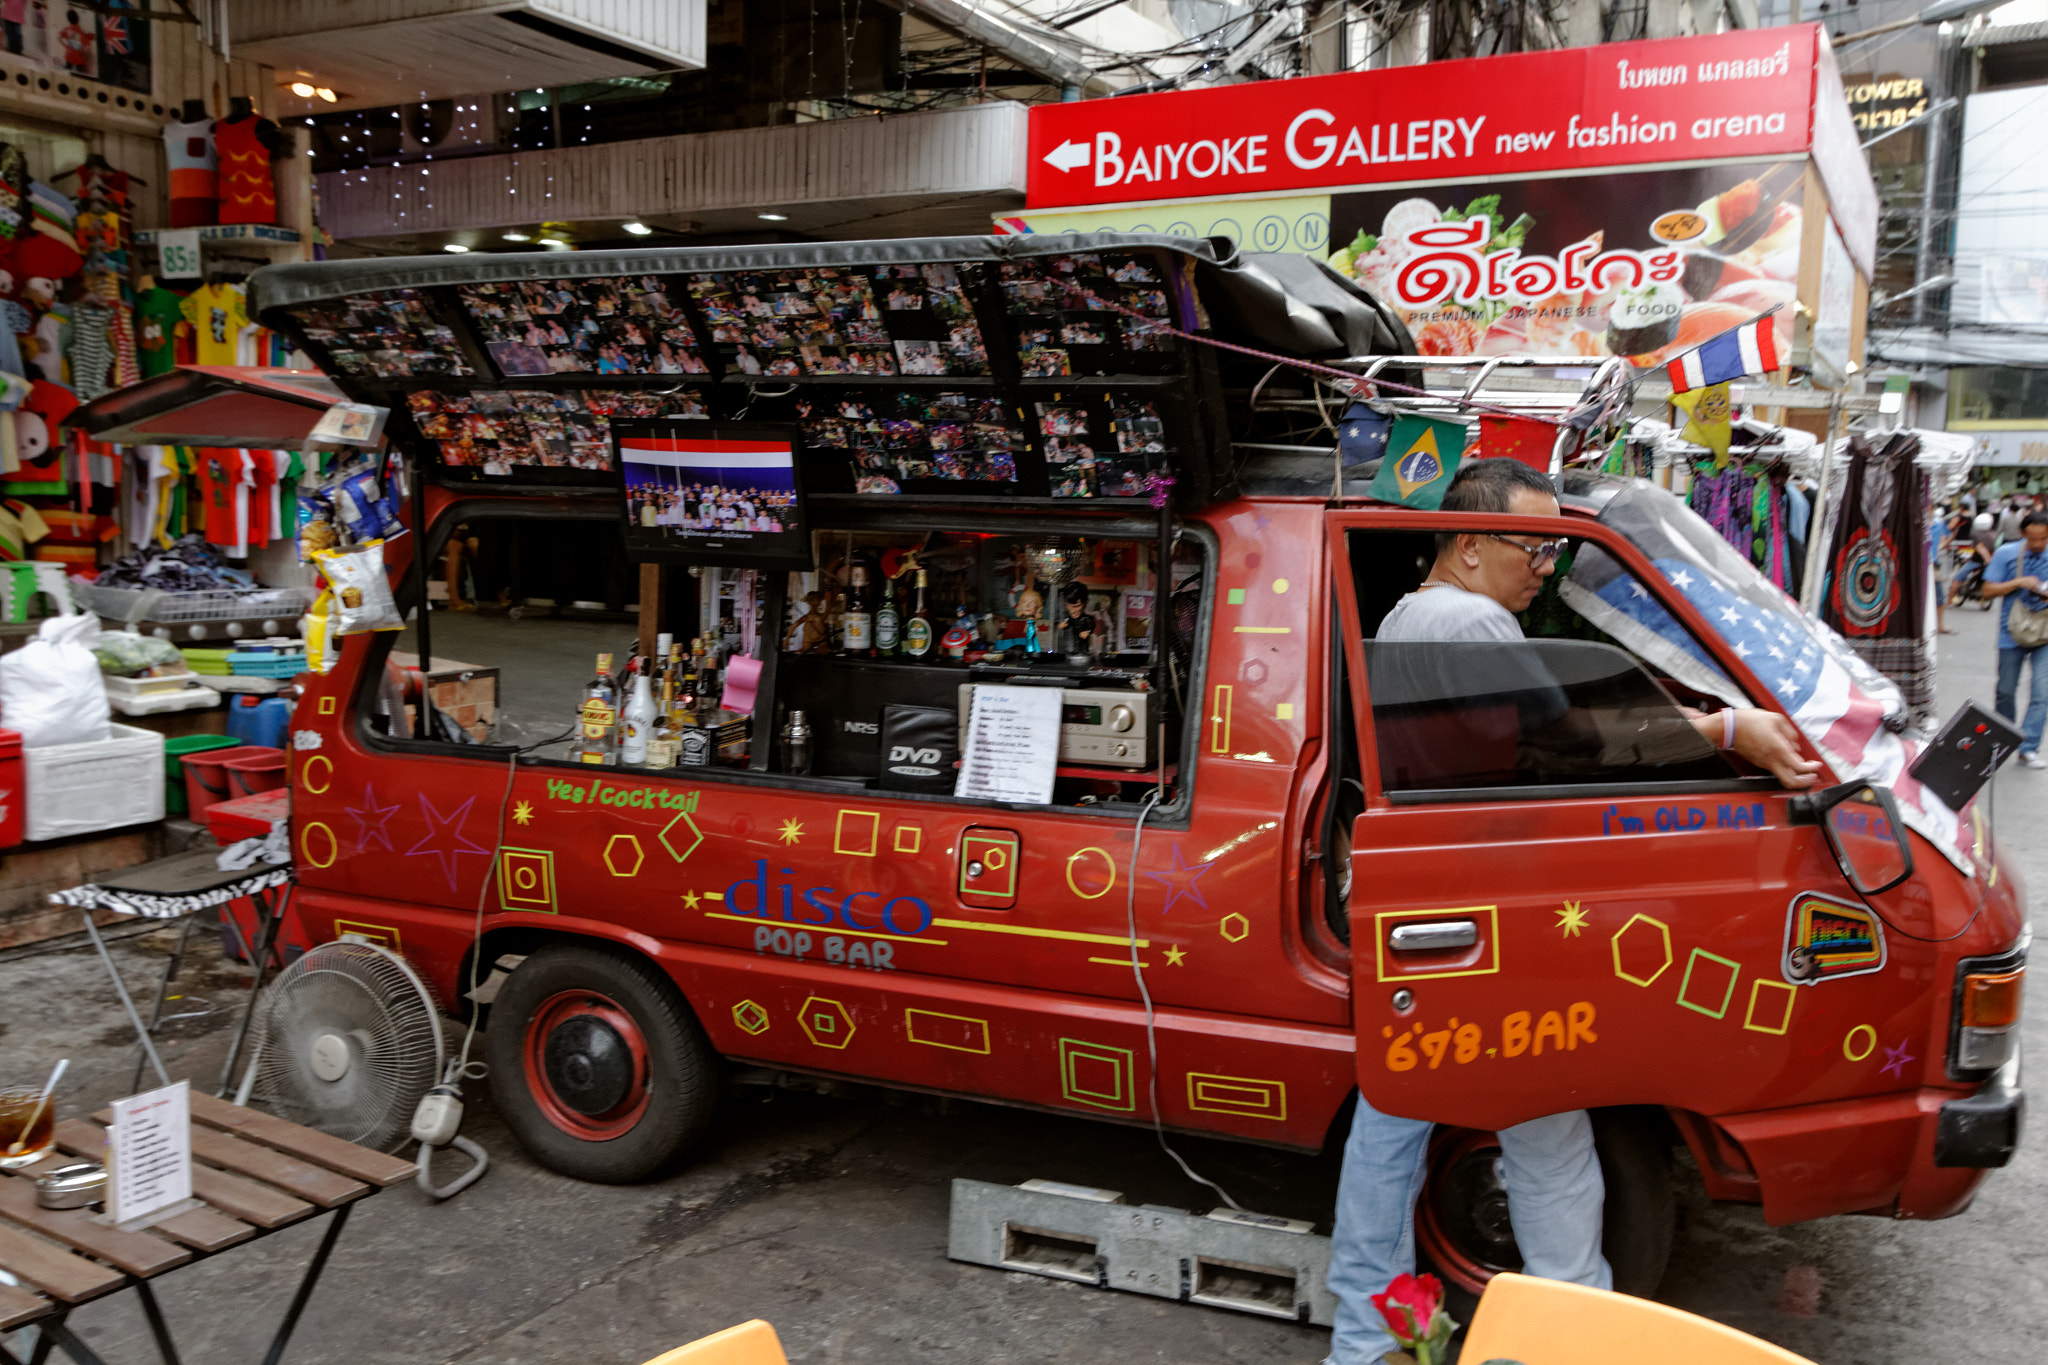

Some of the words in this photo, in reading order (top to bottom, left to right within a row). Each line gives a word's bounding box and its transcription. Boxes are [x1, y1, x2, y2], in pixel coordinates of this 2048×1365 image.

[1495, 130, 1555, 154] new
[1567, 111, 1677, 149] fashion
[1691, 112, 1786, 139] arena
[1409, 310, 1485, 323] PREMIUM
[1506, 305, 1598, 320] JAPANESE
[1626, 303, 1678, 317] FOOD
[844, 721, 879, 735] NRS
[888, 745, 942, 764] DVD
[1655, 806, 1707, 832] OLD
[1717, 803, 1765, 831] MAN
[724, 859, 932, 935] disco
[754, 925, 812, 962] POP
[824, 935, 896, 972] BAR
[1810, 918, 1873, 950] DISCO
